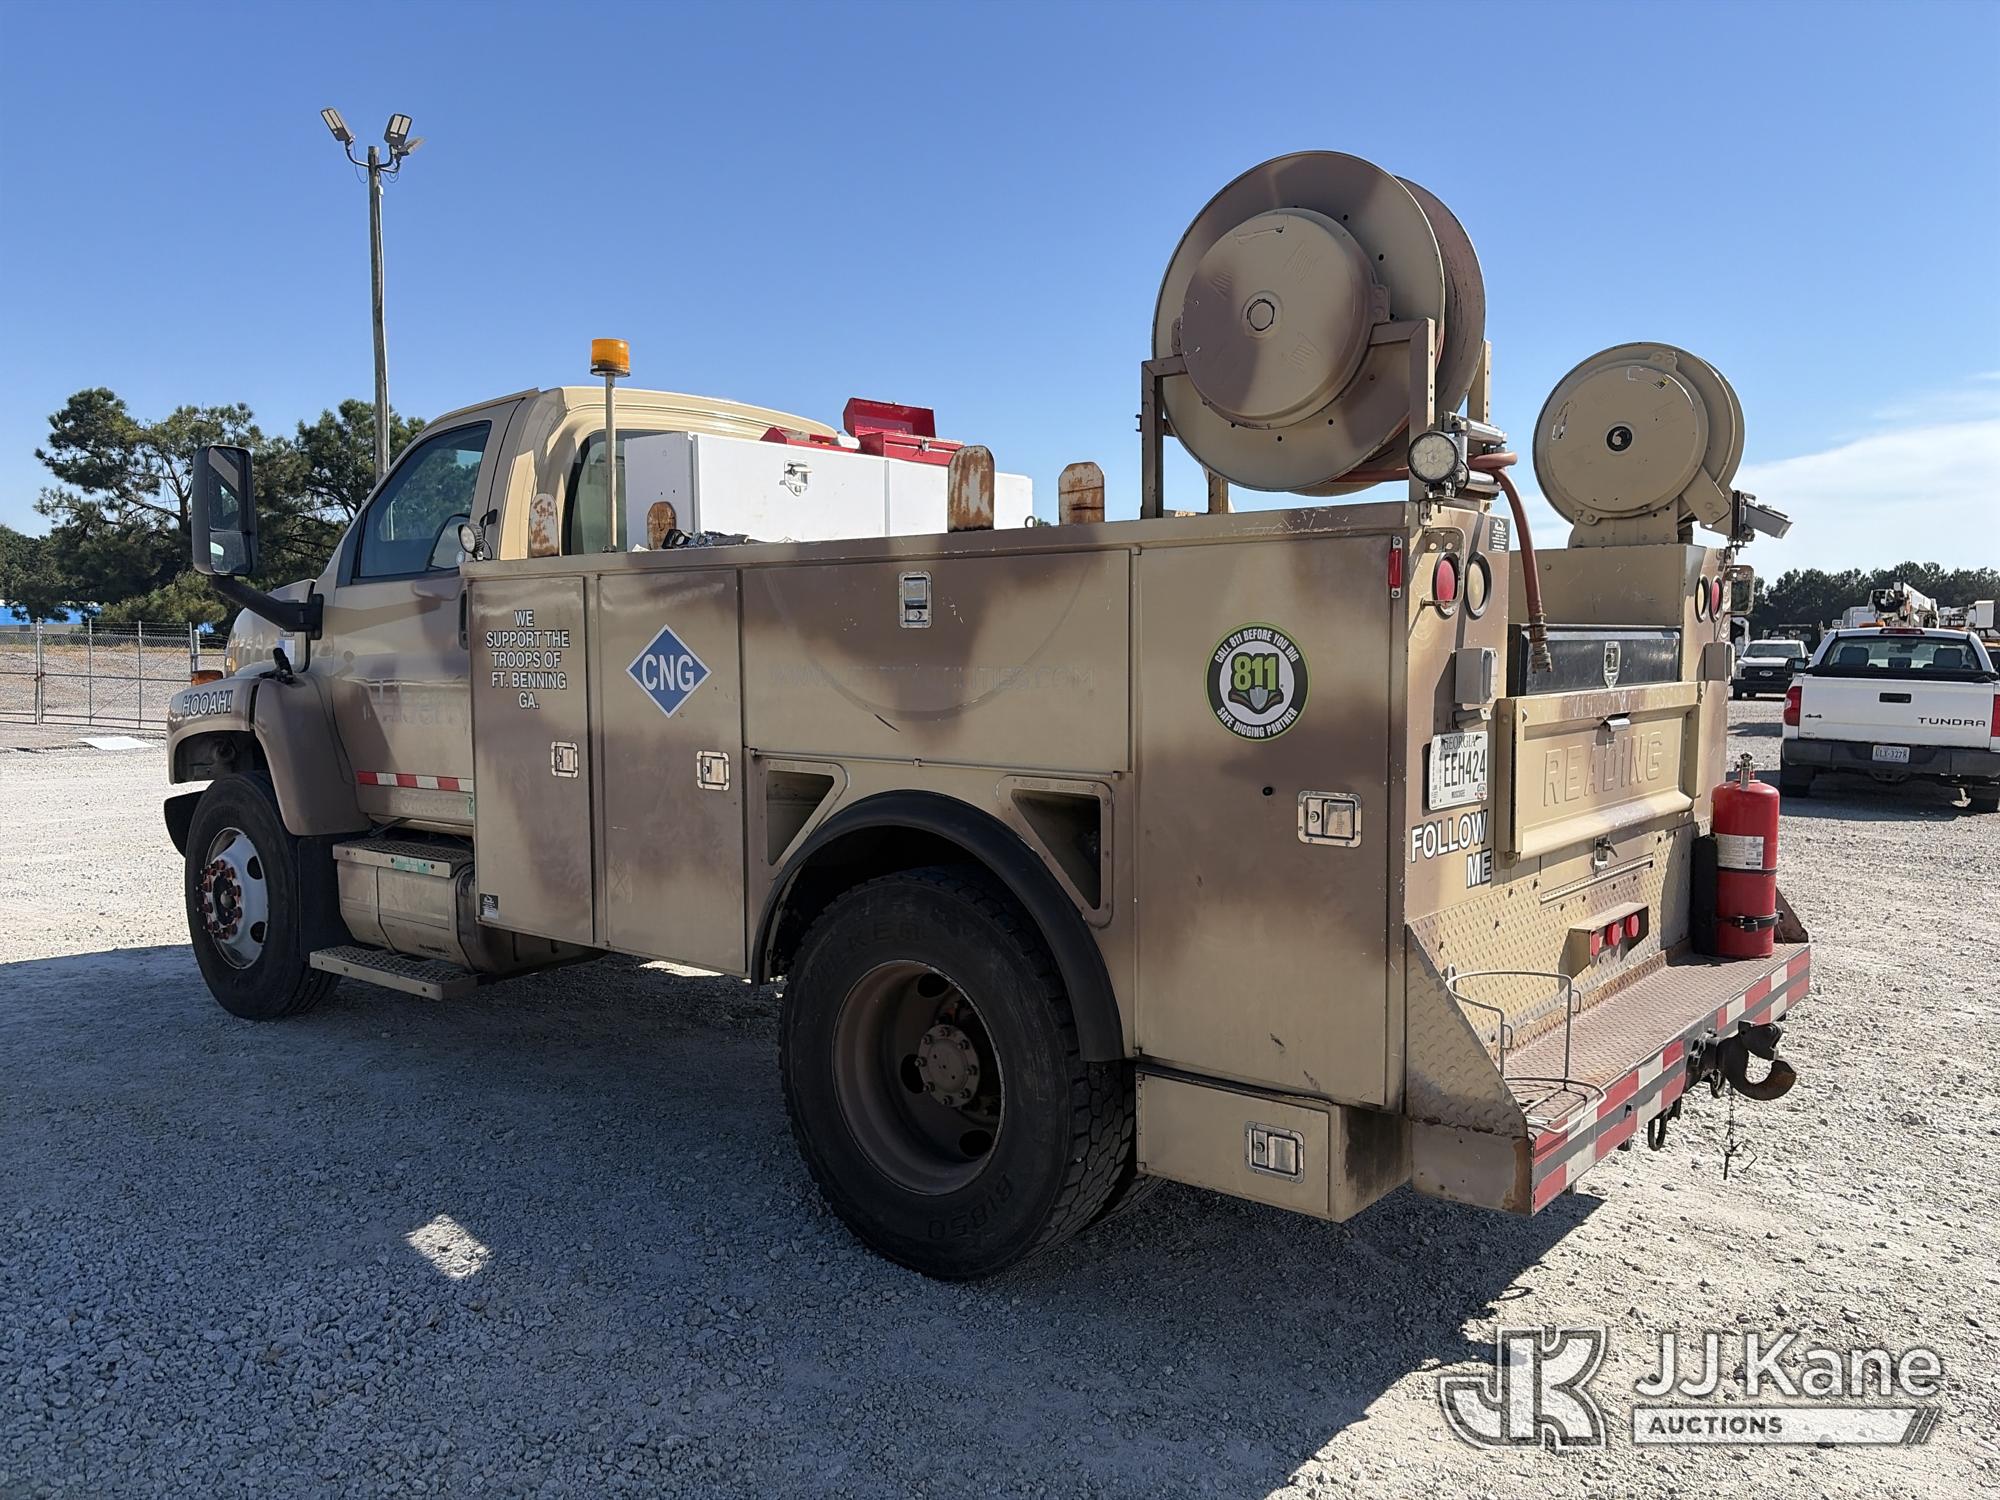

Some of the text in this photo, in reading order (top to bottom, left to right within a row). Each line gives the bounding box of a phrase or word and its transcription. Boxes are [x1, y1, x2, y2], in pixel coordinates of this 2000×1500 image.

[514, 609, 534, 627] WE
[486, 630, 570, 649] SUPPORT THE
[1215, 628, 1299, 663] CALL 811 BEFORE YOU DIG
[491, 651, 561, 669] TROOPS OF
[641, 654, 695, 692] CNG
[1233, 655, 1277, 691] 811
[491, 671, 567, 690] FT. BENNING
[181, 689, 234, 717] HOOAH!
[518, 692, 540, 709] GA.
[1216, 706, 1298, 738] SAFE DIGGING PARTNER
[1917, 716, 1986, 727] TUNDRA
[1443, 735, 1478, 750] GEORGIA
[1444, 749, 1486, 788] EEH424
[1411, 809, 1489, 864] FOLLOW
[1466, 848, 1492, 889] ME
